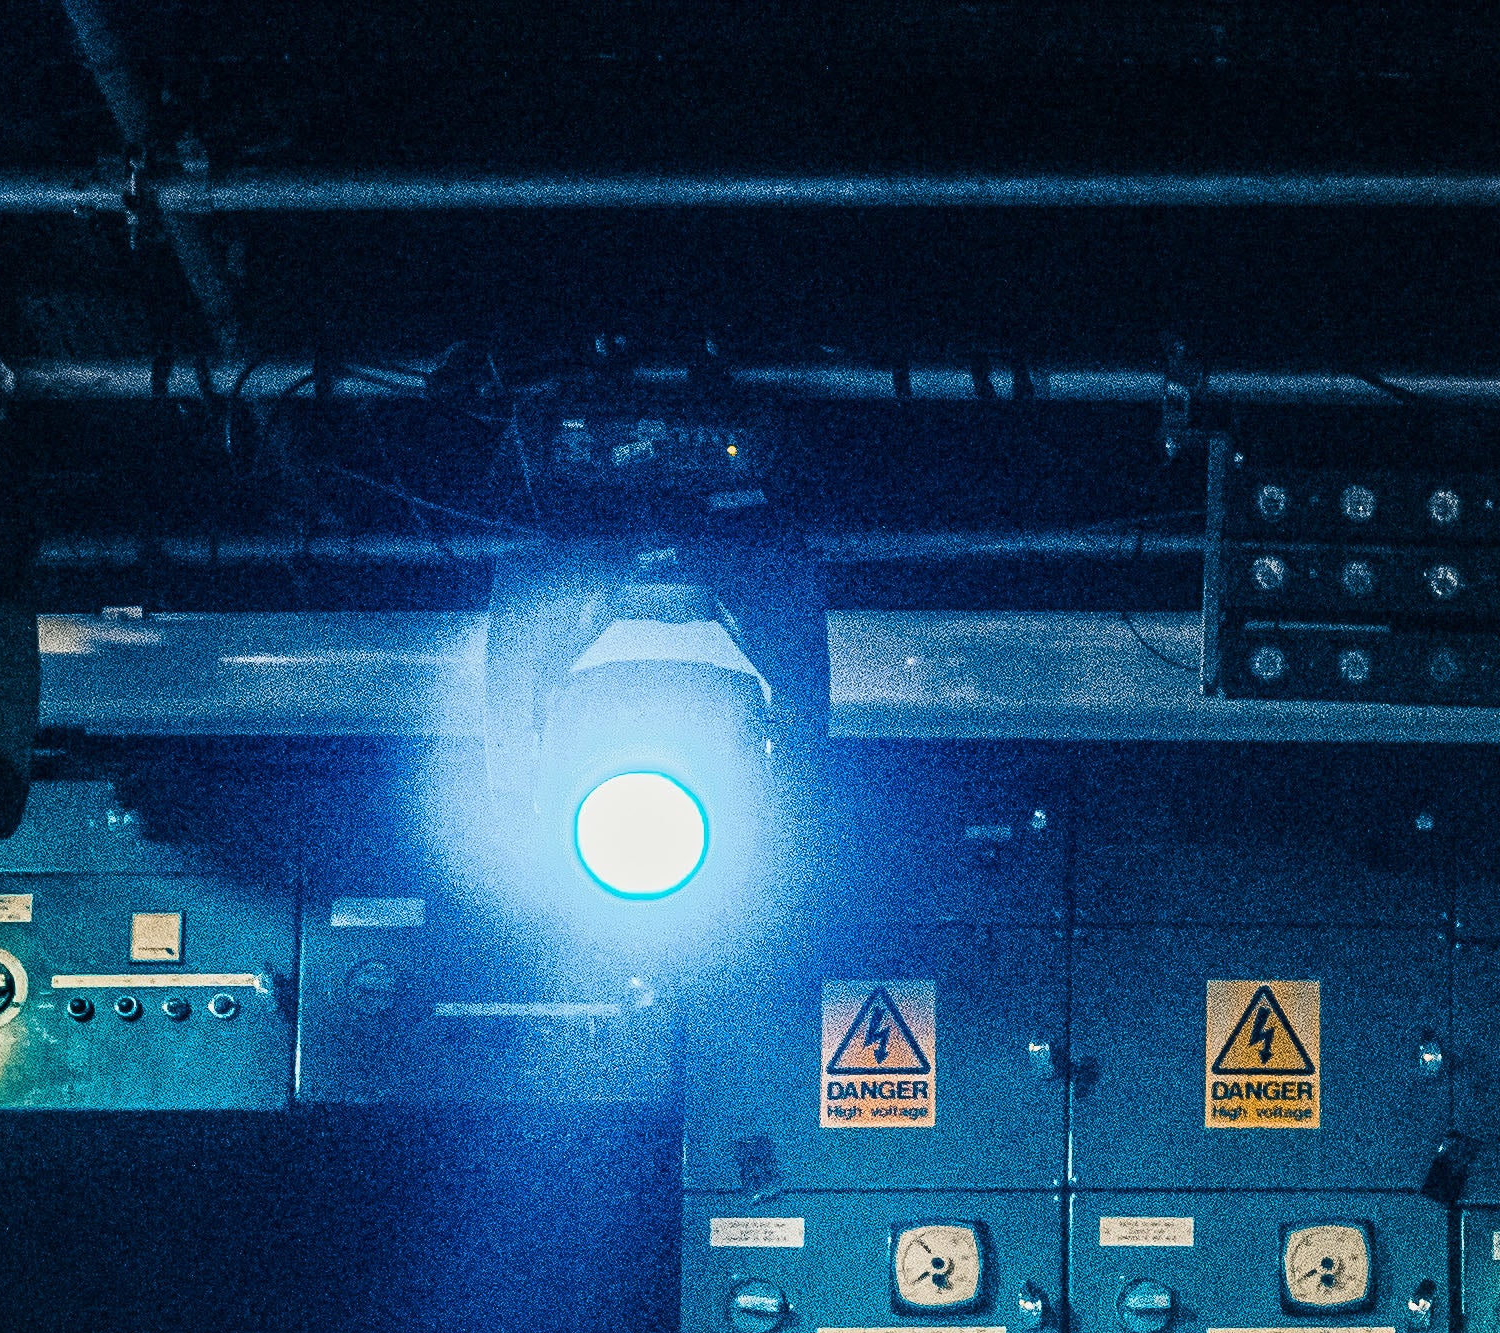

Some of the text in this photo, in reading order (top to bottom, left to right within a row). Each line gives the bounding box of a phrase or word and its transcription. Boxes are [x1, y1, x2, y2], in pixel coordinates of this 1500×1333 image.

[827, 1081, 929, 1101] DANGER
[1212, 1081, 1314, 1101] DANGER
[827, 1105, 929, 1120] High voltage
[1212, 1105, 1313, 1120] High voltage
